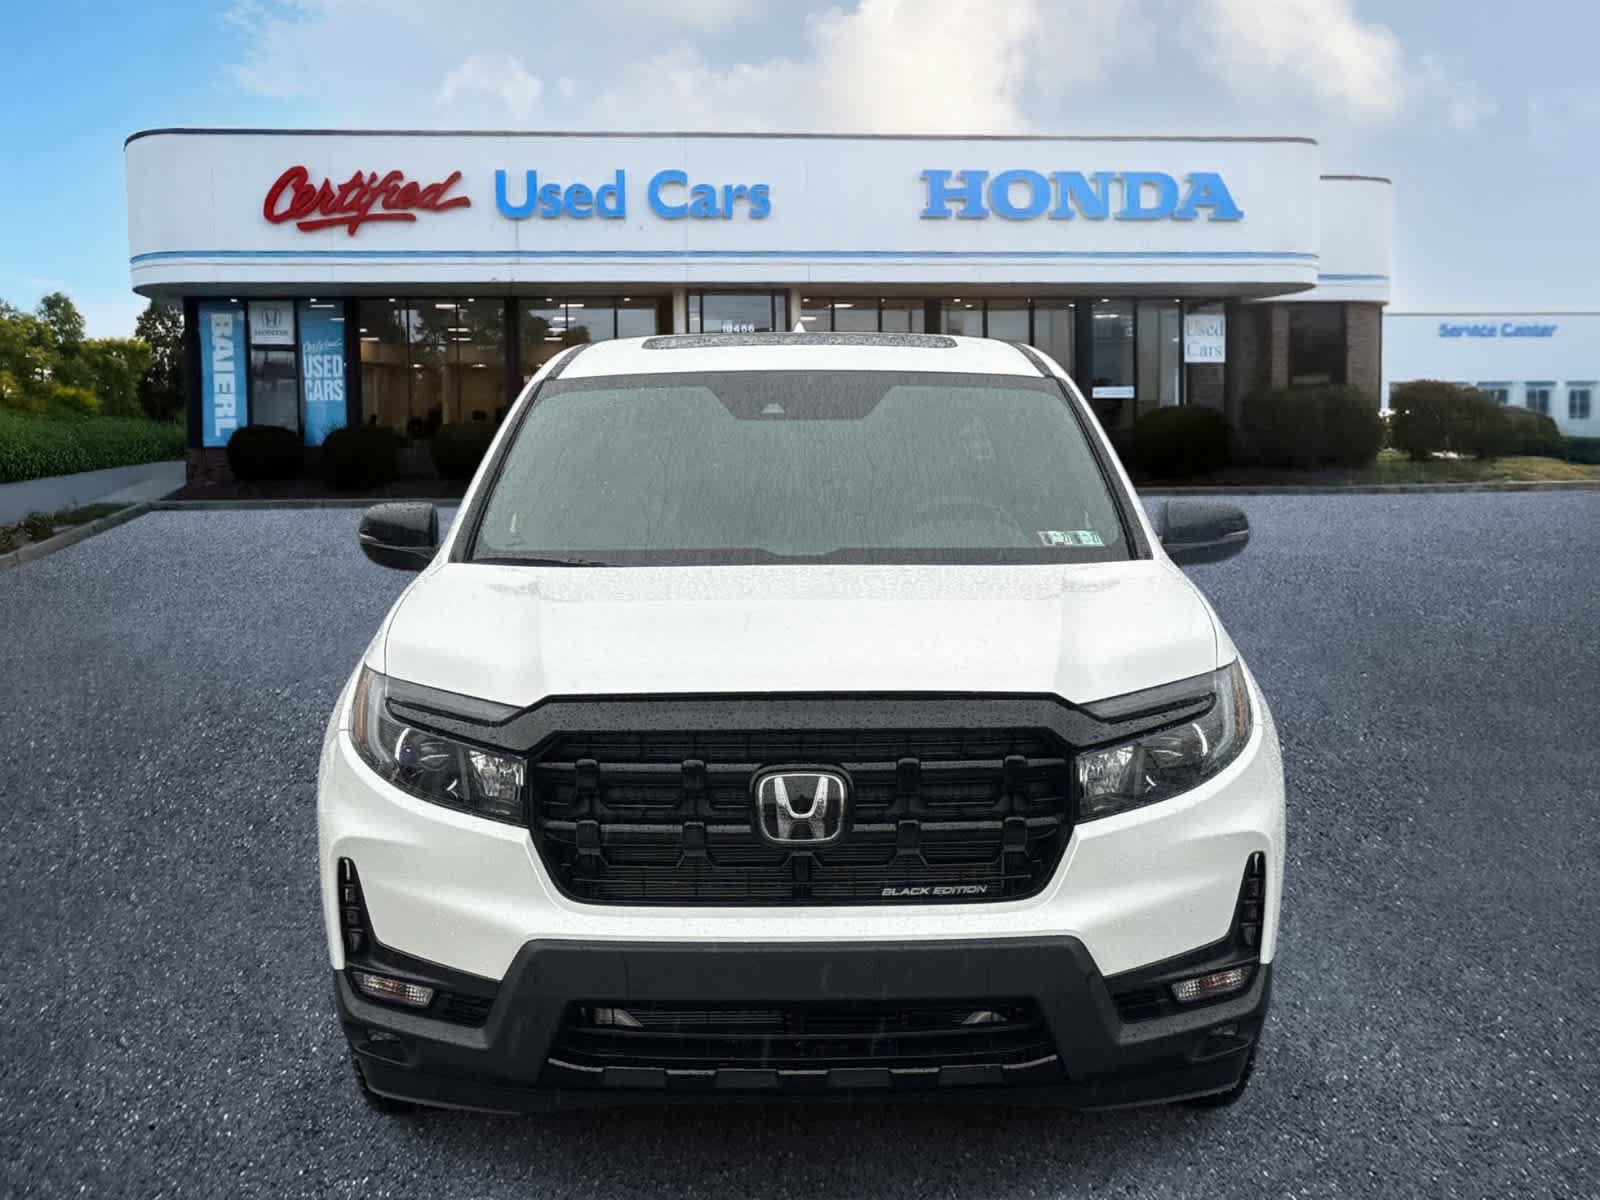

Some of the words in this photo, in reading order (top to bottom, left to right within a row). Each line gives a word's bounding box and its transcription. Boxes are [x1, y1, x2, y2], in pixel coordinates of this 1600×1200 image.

[263, 165, 472, 236] Certified
[495, 169, 626, 220] Used
[648, 170, 772, 220] Cars
[920, 169, 1245, 222] HONDA
[1187, 319, 1224, 337] Used
[1439, 323, 1497, 338] Service
[1501, 323, 1557, 338] Center
[1187, 341, 1223, 358] Cars
[210, 312, 237, 437] BAIERL
[303, 354, 343, 378] USED
[304, 379, 344, 402] CARS
[882, 887, 930, 897] BLACK
[932, 885, 988, 895] EDITION
